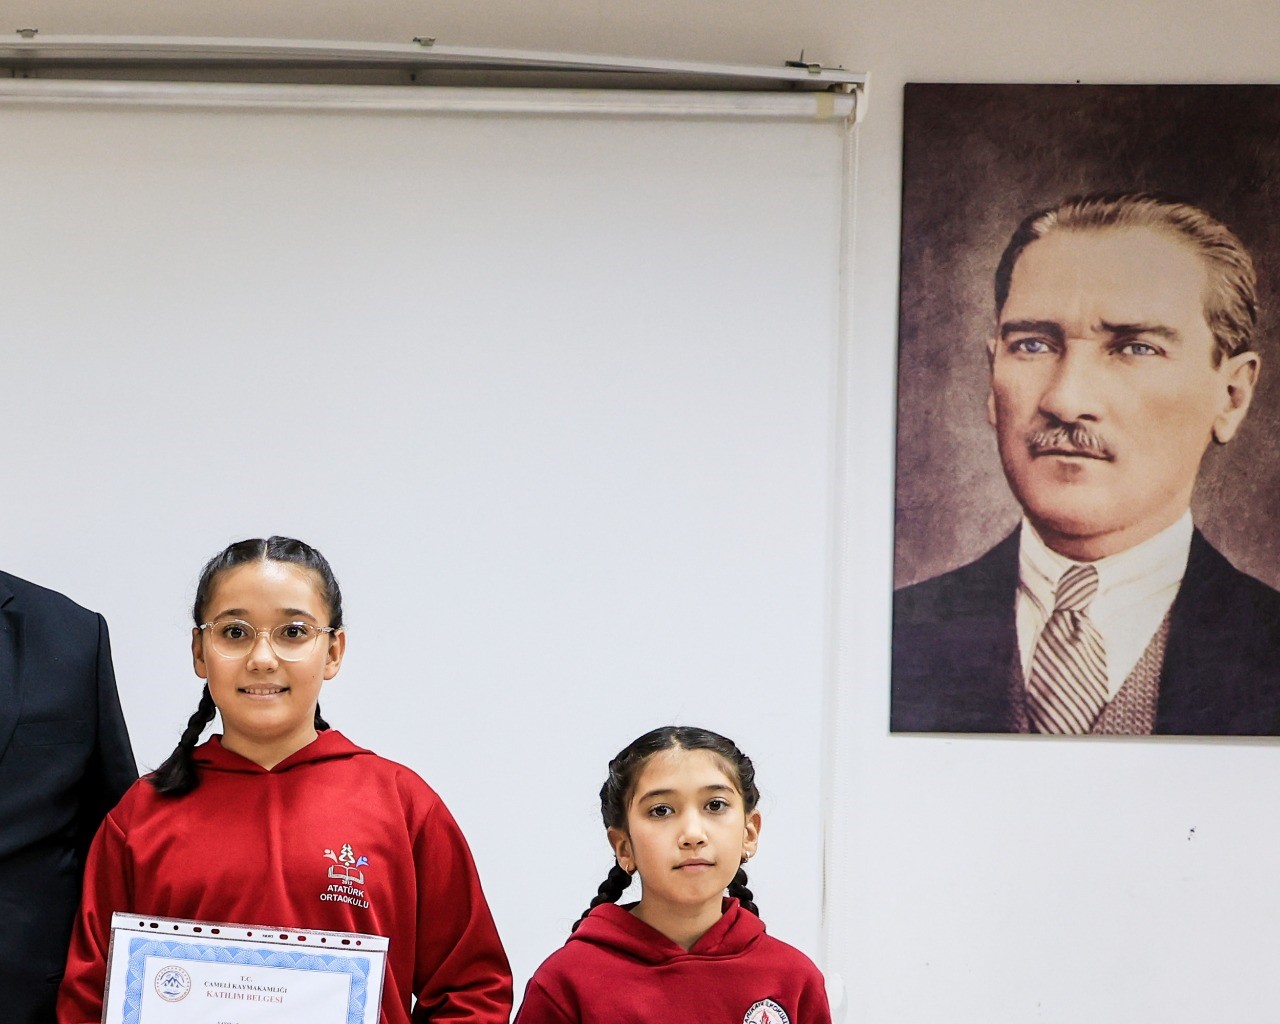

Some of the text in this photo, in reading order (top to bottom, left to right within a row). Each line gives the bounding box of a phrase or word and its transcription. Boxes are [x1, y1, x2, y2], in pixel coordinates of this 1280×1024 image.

[327, 884, 365, 898] ATATÜRK
[319, 893, 369, 909] ORTAOKULU
[206, 990, 283, 1003] KATILIM BELGESİ
